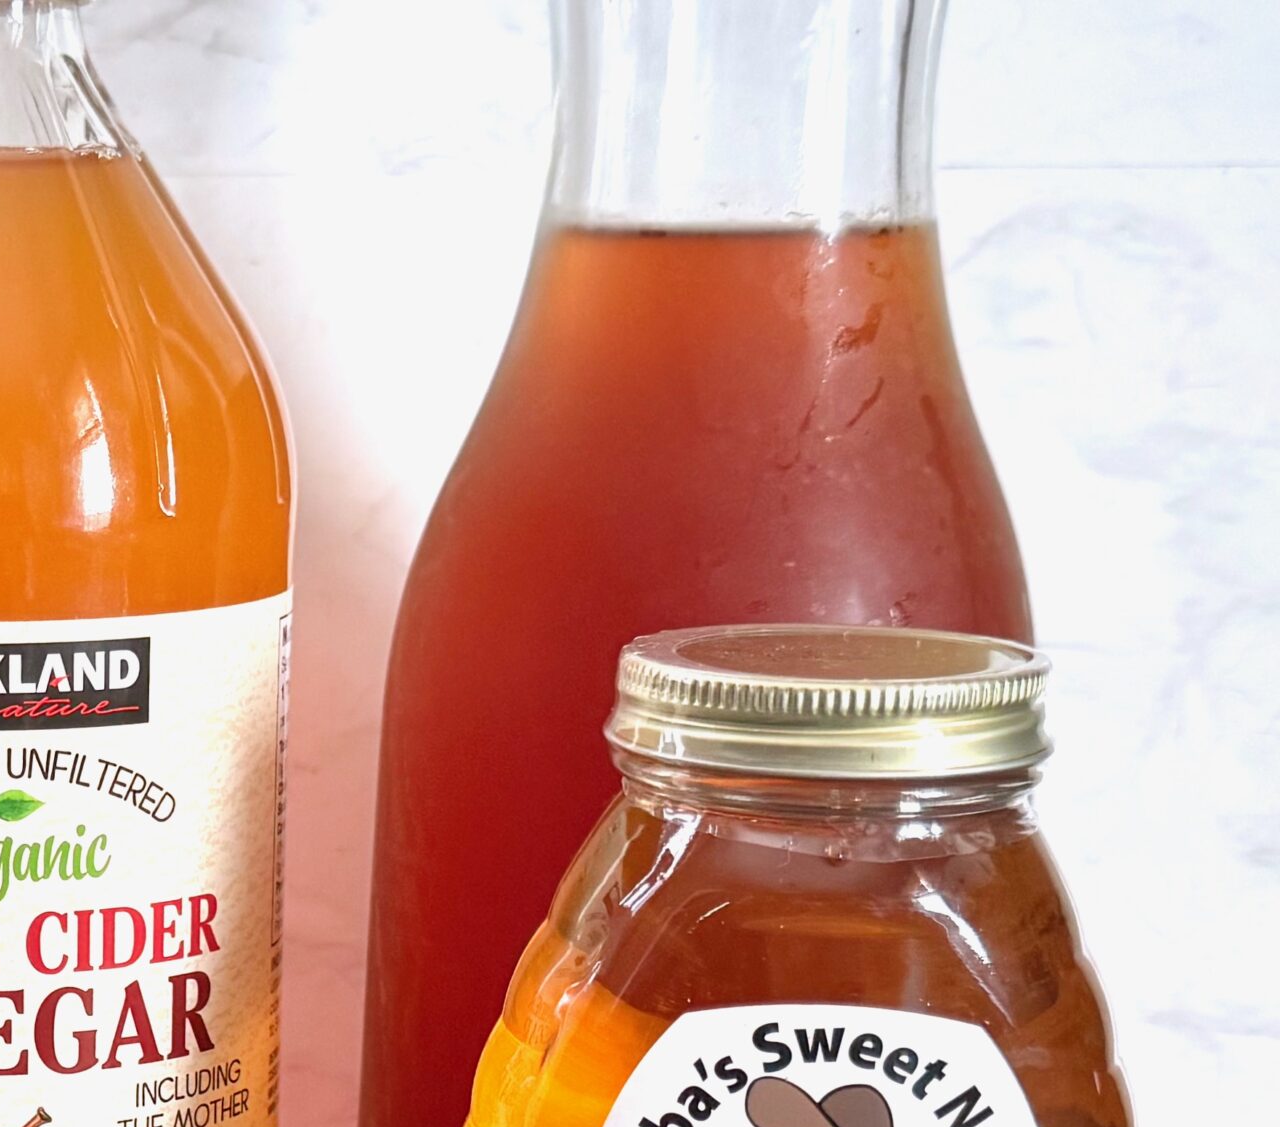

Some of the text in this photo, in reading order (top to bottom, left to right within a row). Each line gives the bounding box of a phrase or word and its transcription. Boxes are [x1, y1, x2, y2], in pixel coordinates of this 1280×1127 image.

[5, 747, 177, 824] UNFILTERED
[25, 892, 221, 977] CIDER
[134, 1059, 243, 1109] INCLUDING
[751, 1021, 949, 1101] Sweet
